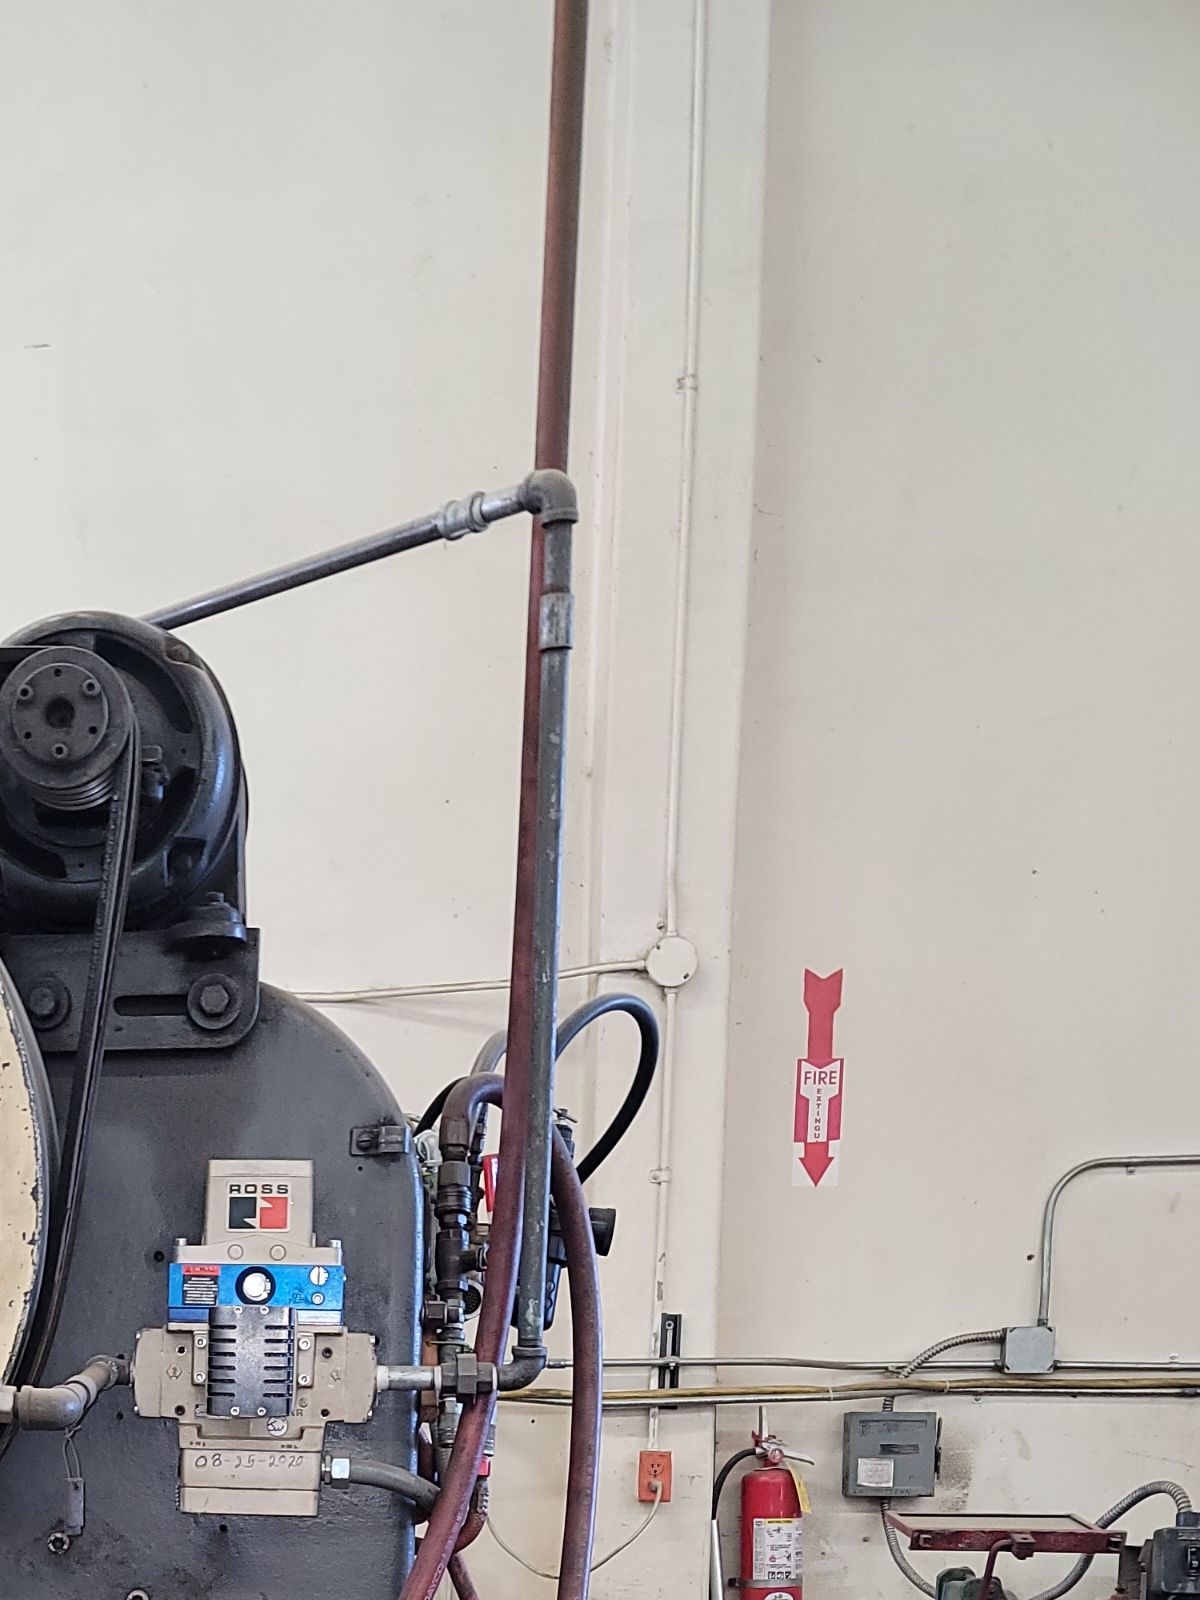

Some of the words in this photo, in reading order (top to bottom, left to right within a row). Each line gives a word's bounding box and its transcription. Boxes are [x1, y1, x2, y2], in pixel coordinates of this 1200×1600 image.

[804, 1071, 837, 1085] FIRE
[814, 1088, 822, 1141] EXTINGU
[229, 1184, 289, 1194] ROSS
